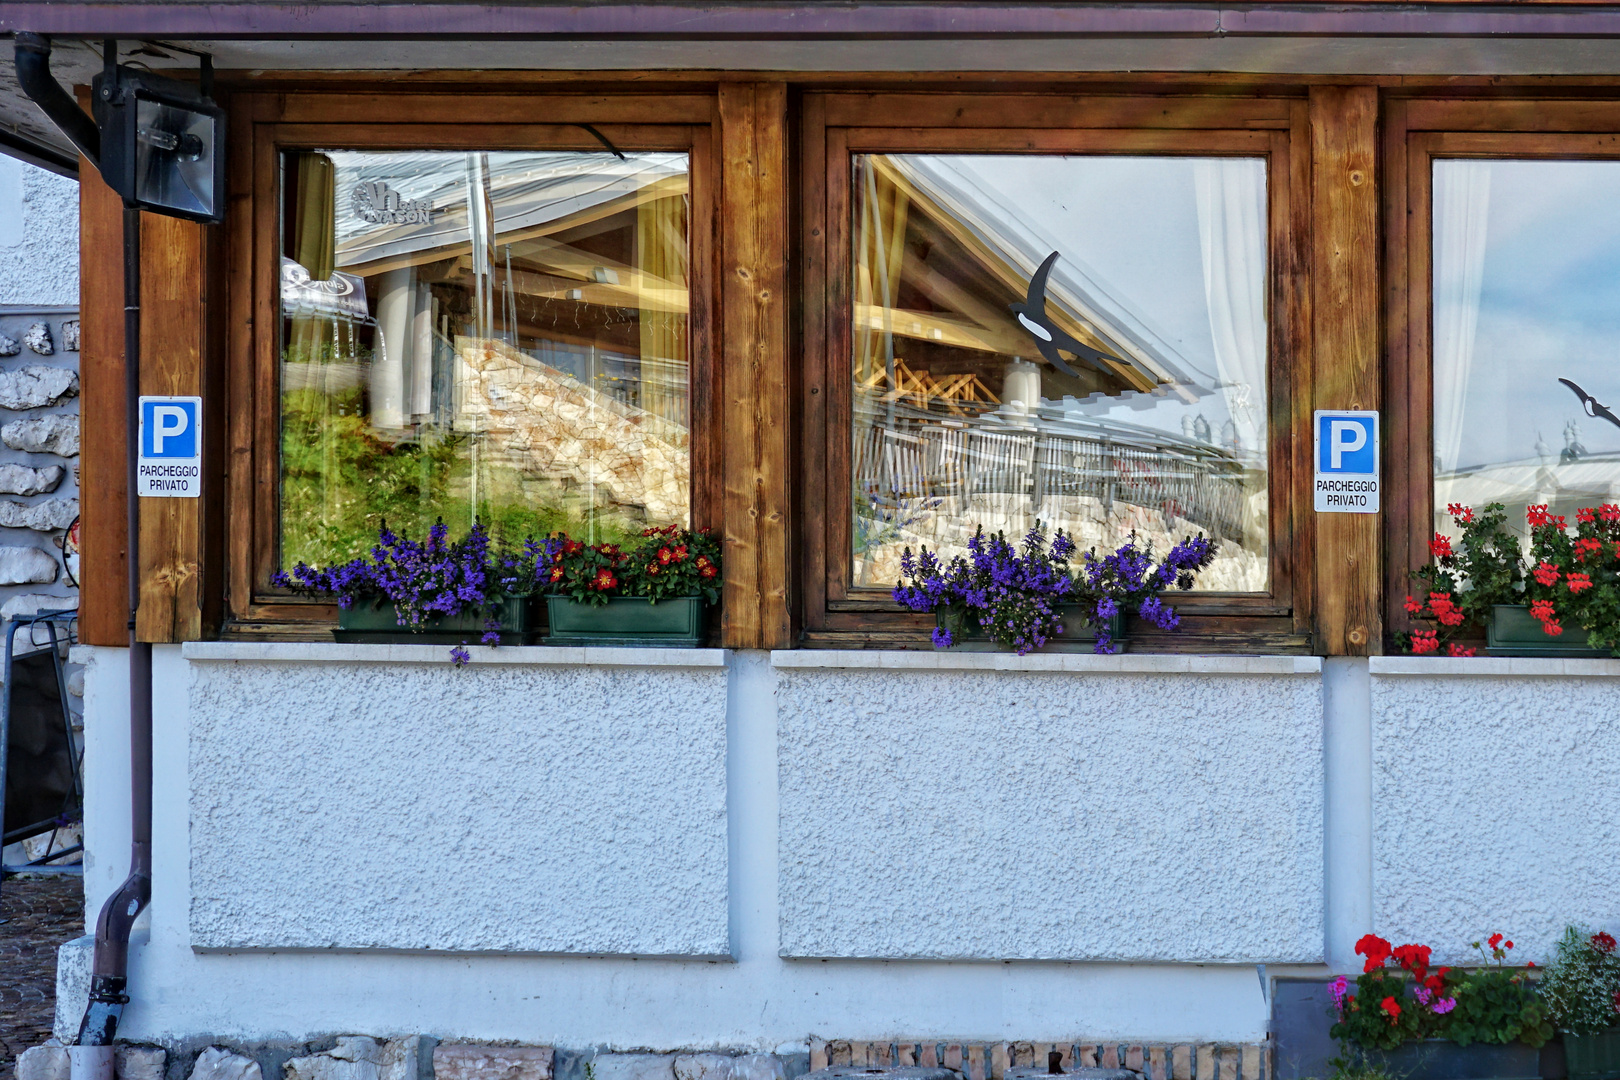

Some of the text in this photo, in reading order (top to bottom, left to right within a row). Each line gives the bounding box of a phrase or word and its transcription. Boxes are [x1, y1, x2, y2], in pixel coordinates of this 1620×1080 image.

[153, 405, 189, 454] P
[1330, 420, 1367, 469] P
[140, 465, 199, 477] PARCHEGGIO
[149, 479, 189, 491] PRIVATO
[1316, 480, 1377, 493] PARCHEGGIO
[1326, 494, 1367, 507] PRIVATO
